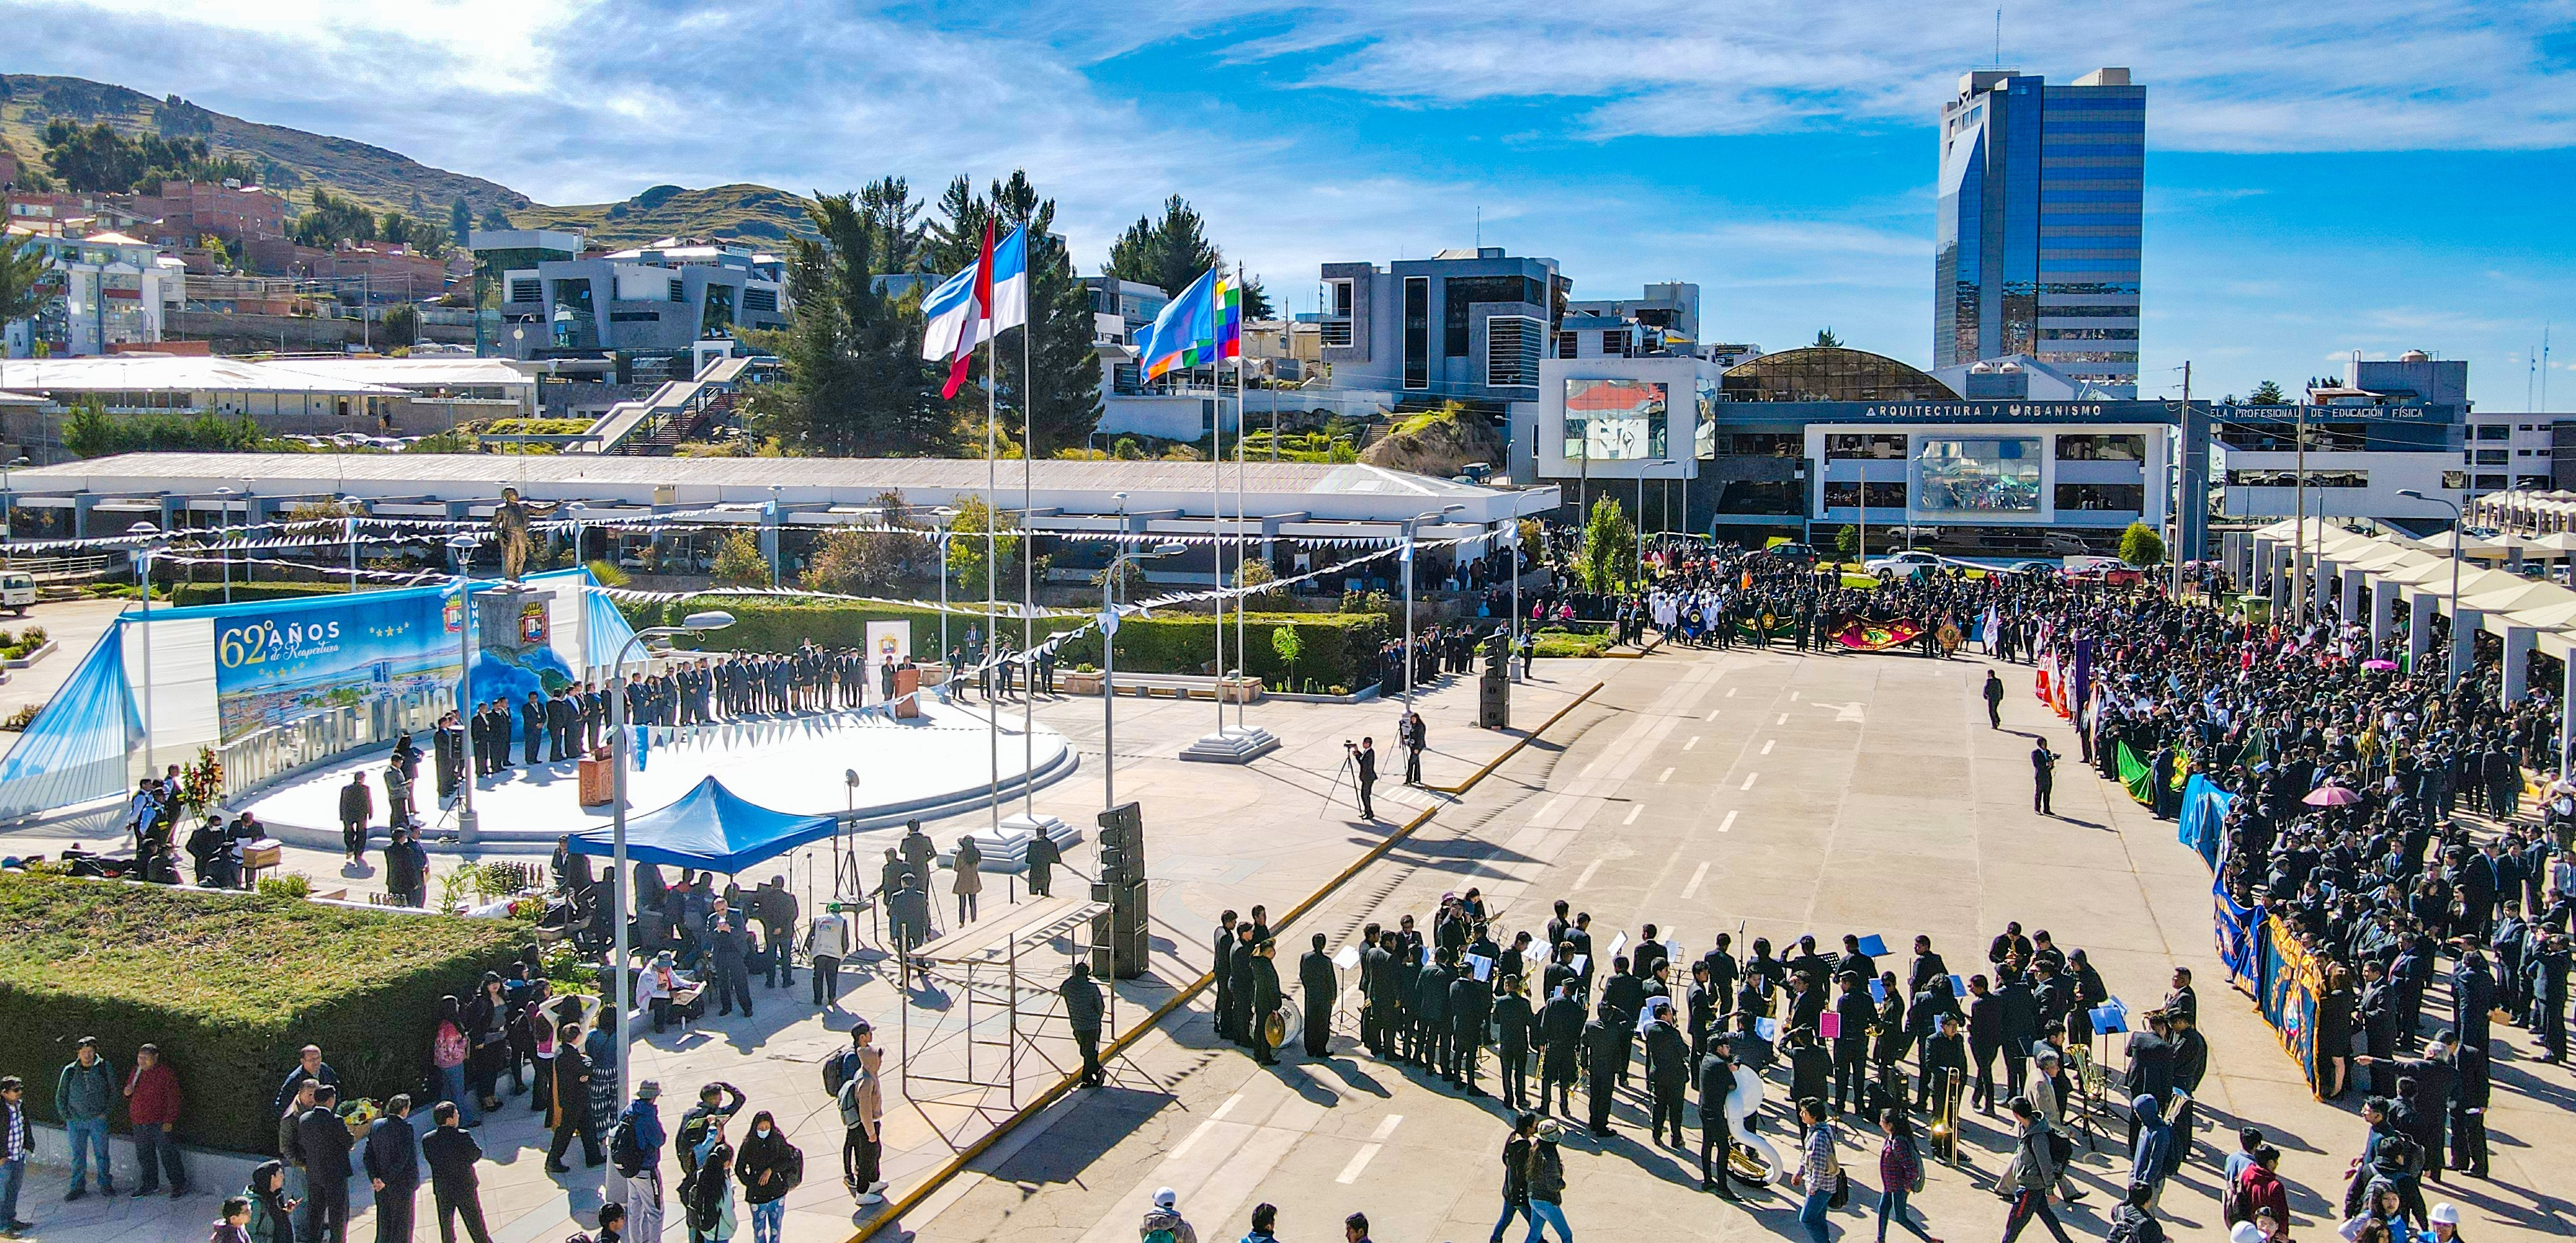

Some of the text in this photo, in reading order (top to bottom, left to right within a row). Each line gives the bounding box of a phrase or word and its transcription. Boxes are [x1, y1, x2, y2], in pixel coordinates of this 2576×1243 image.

[1865, 405, 1981, 416] ARQUITECTURA
[2008, 403, 2101, 416] URBANISMO
[2210, 405, 2423, 418] ELA PROFESIONAL DE EDUCACIÓN FÍSICA
[471, 601, 480, 629] UNA
[268, 621, 339, 647] AÑOS
[270, 639, 341, 661] de Reapertura
[219, 687, 456, 798] UNIVERSIDAD NACIO
